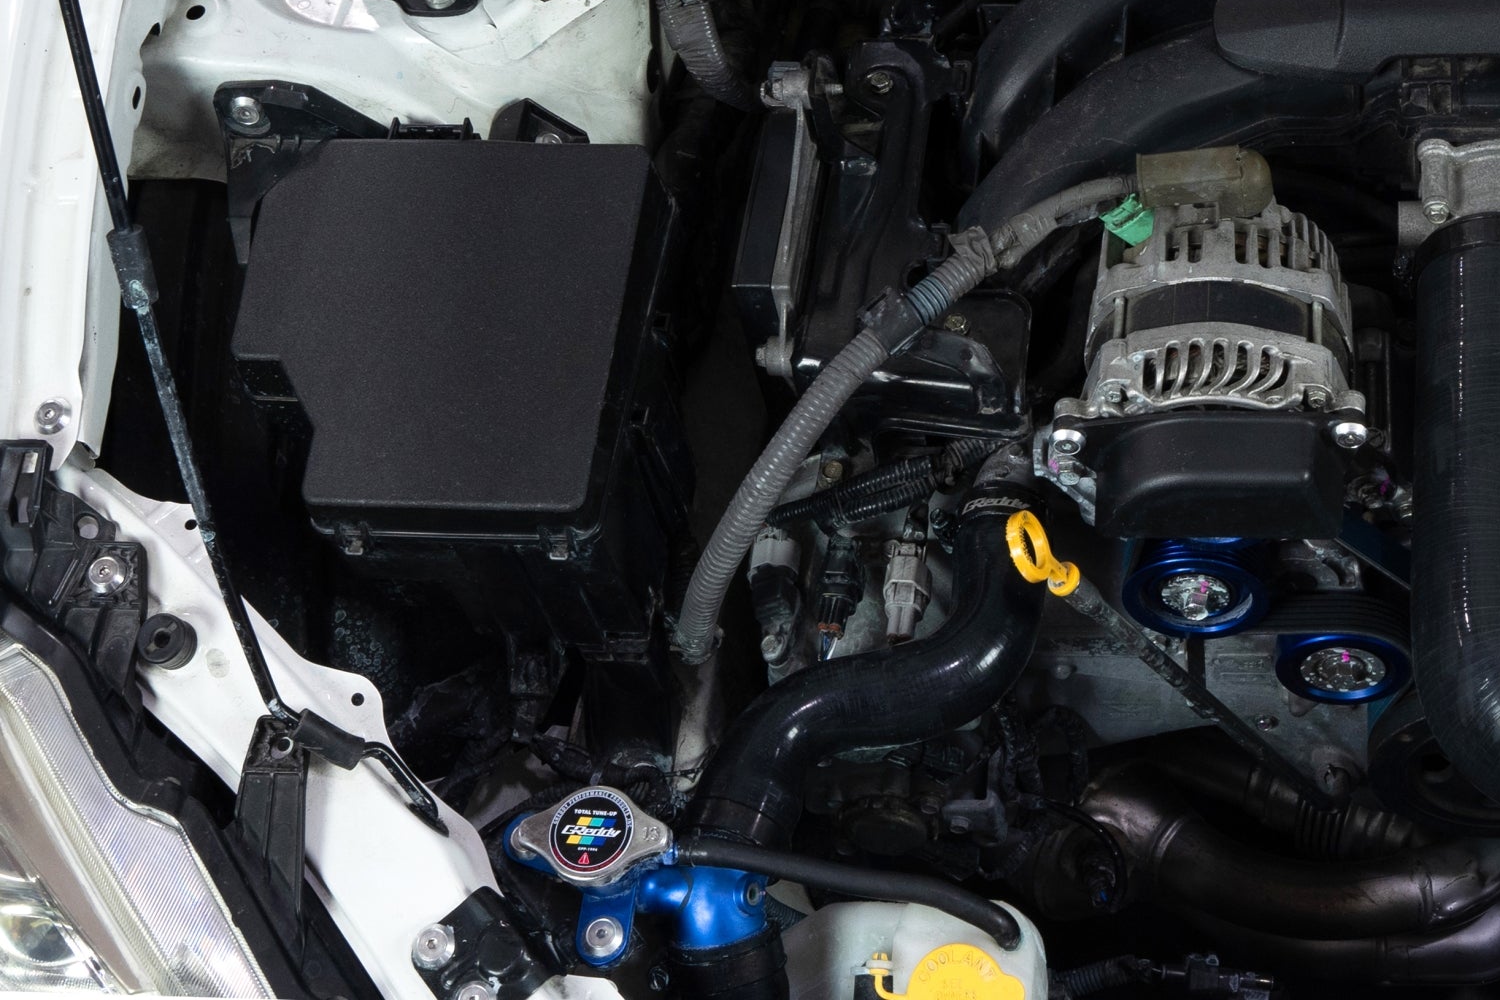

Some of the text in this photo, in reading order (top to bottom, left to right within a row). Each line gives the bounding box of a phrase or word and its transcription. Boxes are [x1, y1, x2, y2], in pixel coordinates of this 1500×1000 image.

[574, 808, 618, 817] TOTAL TUNE-UP
[561, 823, 622, 839] GReddy
[918, 949, 997, 982] COOLANT
